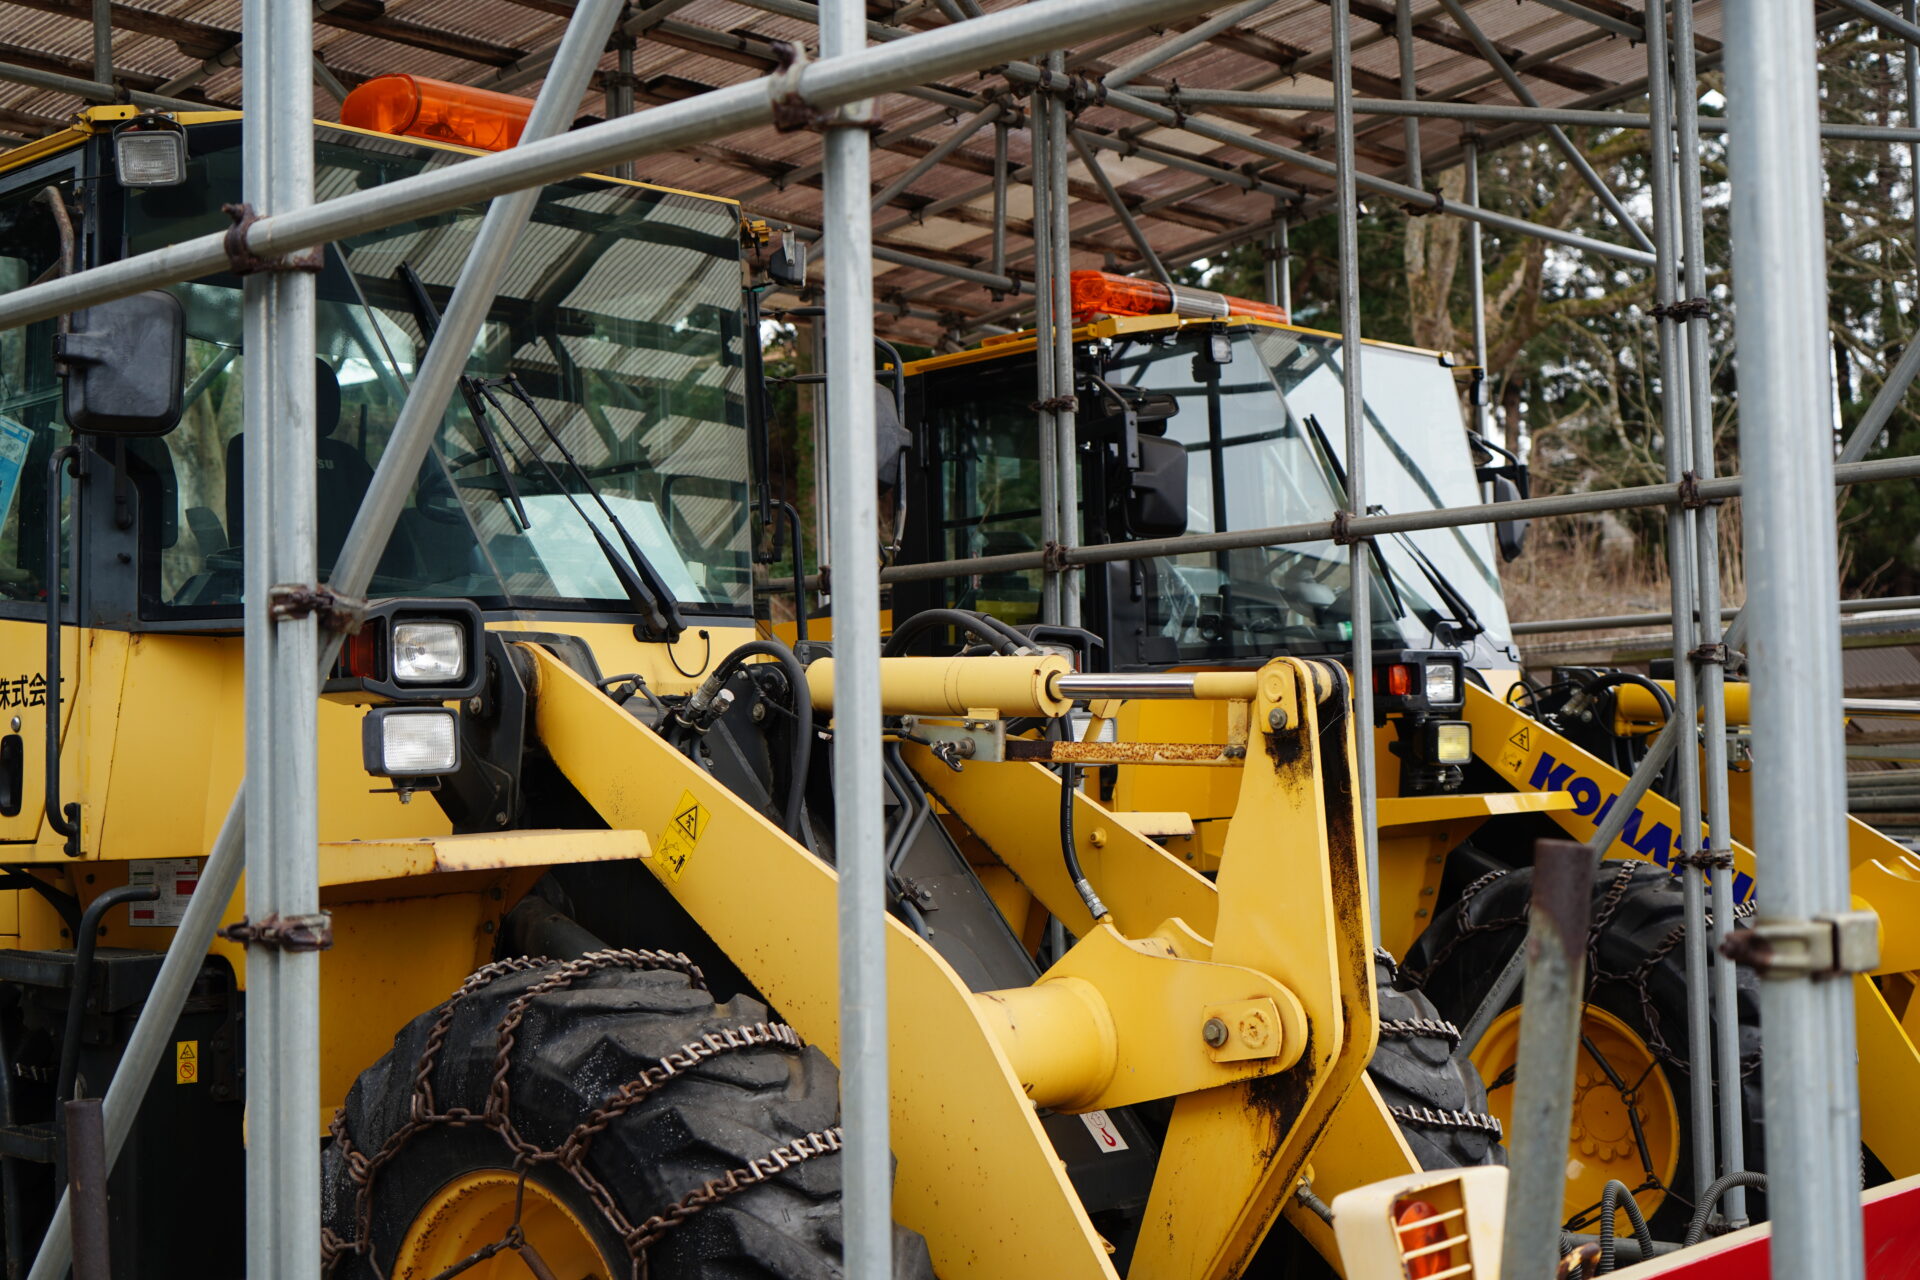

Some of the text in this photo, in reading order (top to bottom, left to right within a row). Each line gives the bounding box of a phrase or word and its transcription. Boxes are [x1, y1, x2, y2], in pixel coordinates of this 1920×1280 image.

[0, 672, 64, 710] 株式会
[1529, 752, 1758, 905] KOMA
